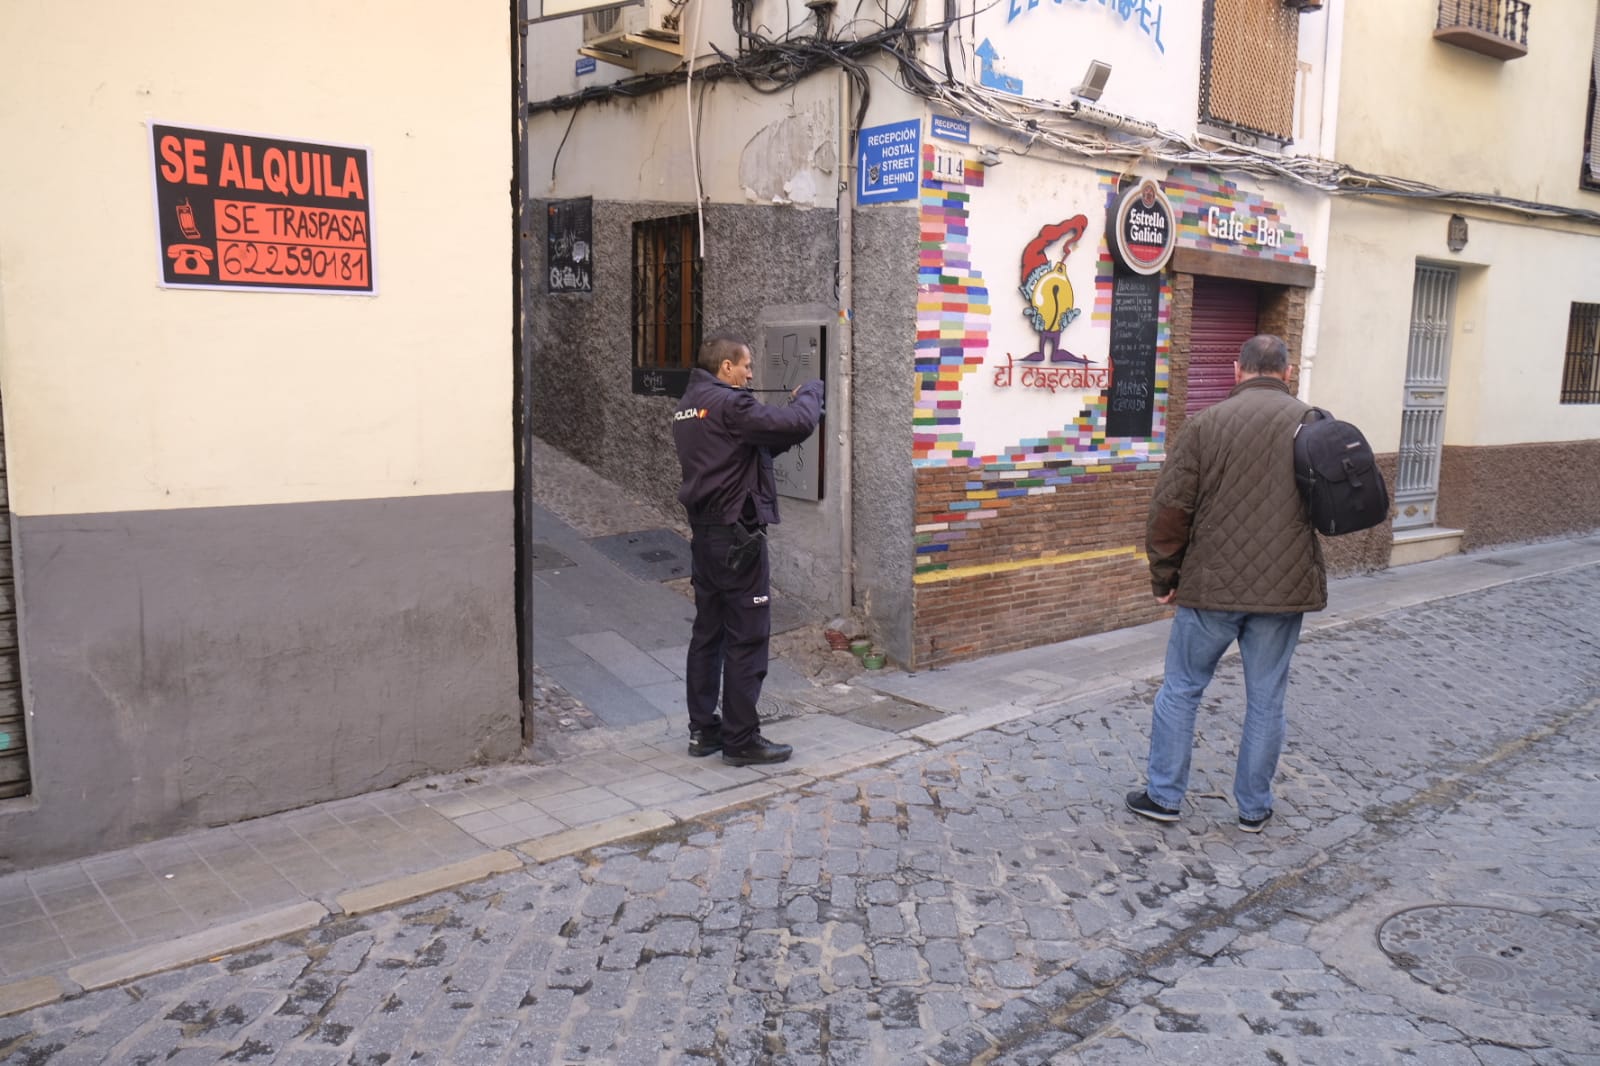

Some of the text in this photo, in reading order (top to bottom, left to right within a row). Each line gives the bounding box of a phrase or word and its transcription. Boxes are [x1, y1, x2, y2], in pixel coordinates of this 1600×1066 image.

[867, 128, 916, 147] RECEPCIÓN
[882, 144, 915, 158] HOSTAL
[160, 135, 364, 200] SE ALQUILA
[882, 157, 914, 171] STREET
[937, 155, 963, 176] 114
[883, 172, 914, 185] BEHIND
[222, 203, 366, 243] SE TRASPASA
[1129, 208, 1164, 228] Estrella
[1130, 225, 1162, 244] Galicia
[224, 242, 364, 281] 622590181
